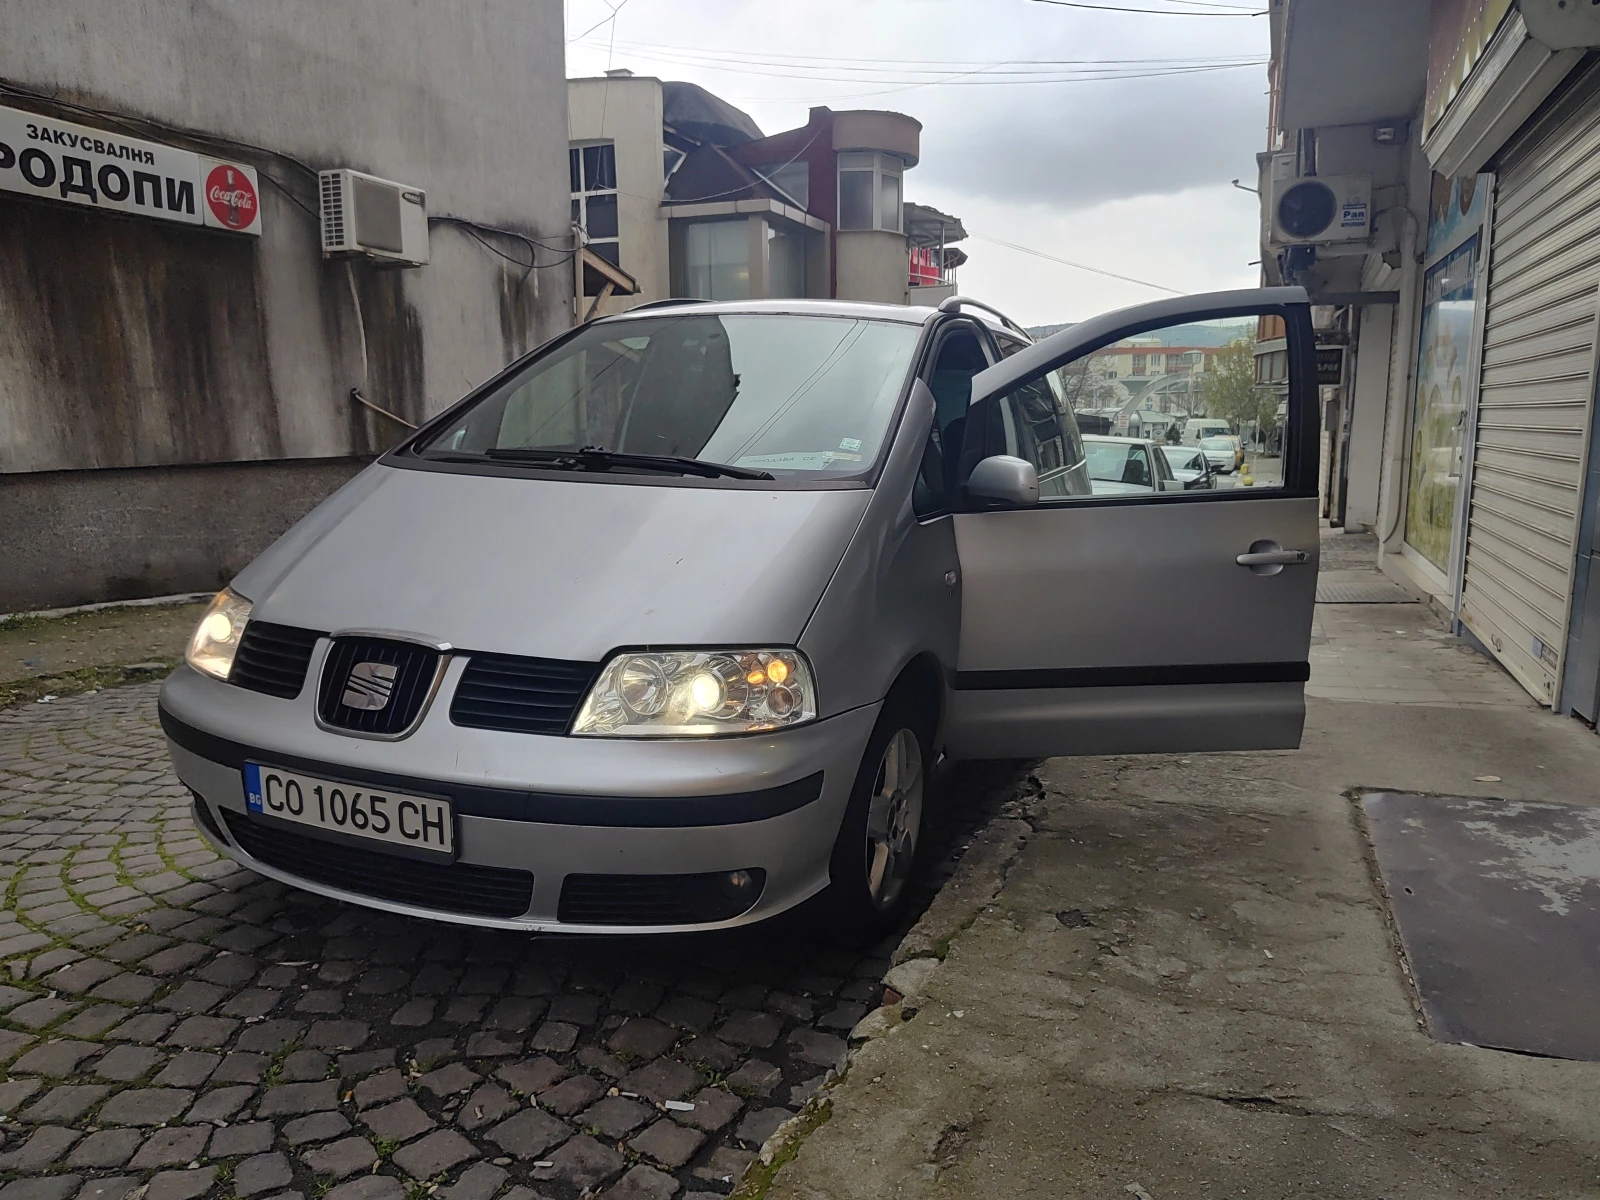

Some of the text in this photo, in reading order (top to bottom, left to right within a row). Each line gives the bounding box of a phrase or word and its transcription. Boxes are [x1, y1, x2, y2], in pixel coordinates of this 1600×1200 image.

[26, 123, 155, 165] ЗАКУСВАЛНЯ
[249, 792, 261, 805] BG
[265, 774, 445, 845] CO 1065 CH
